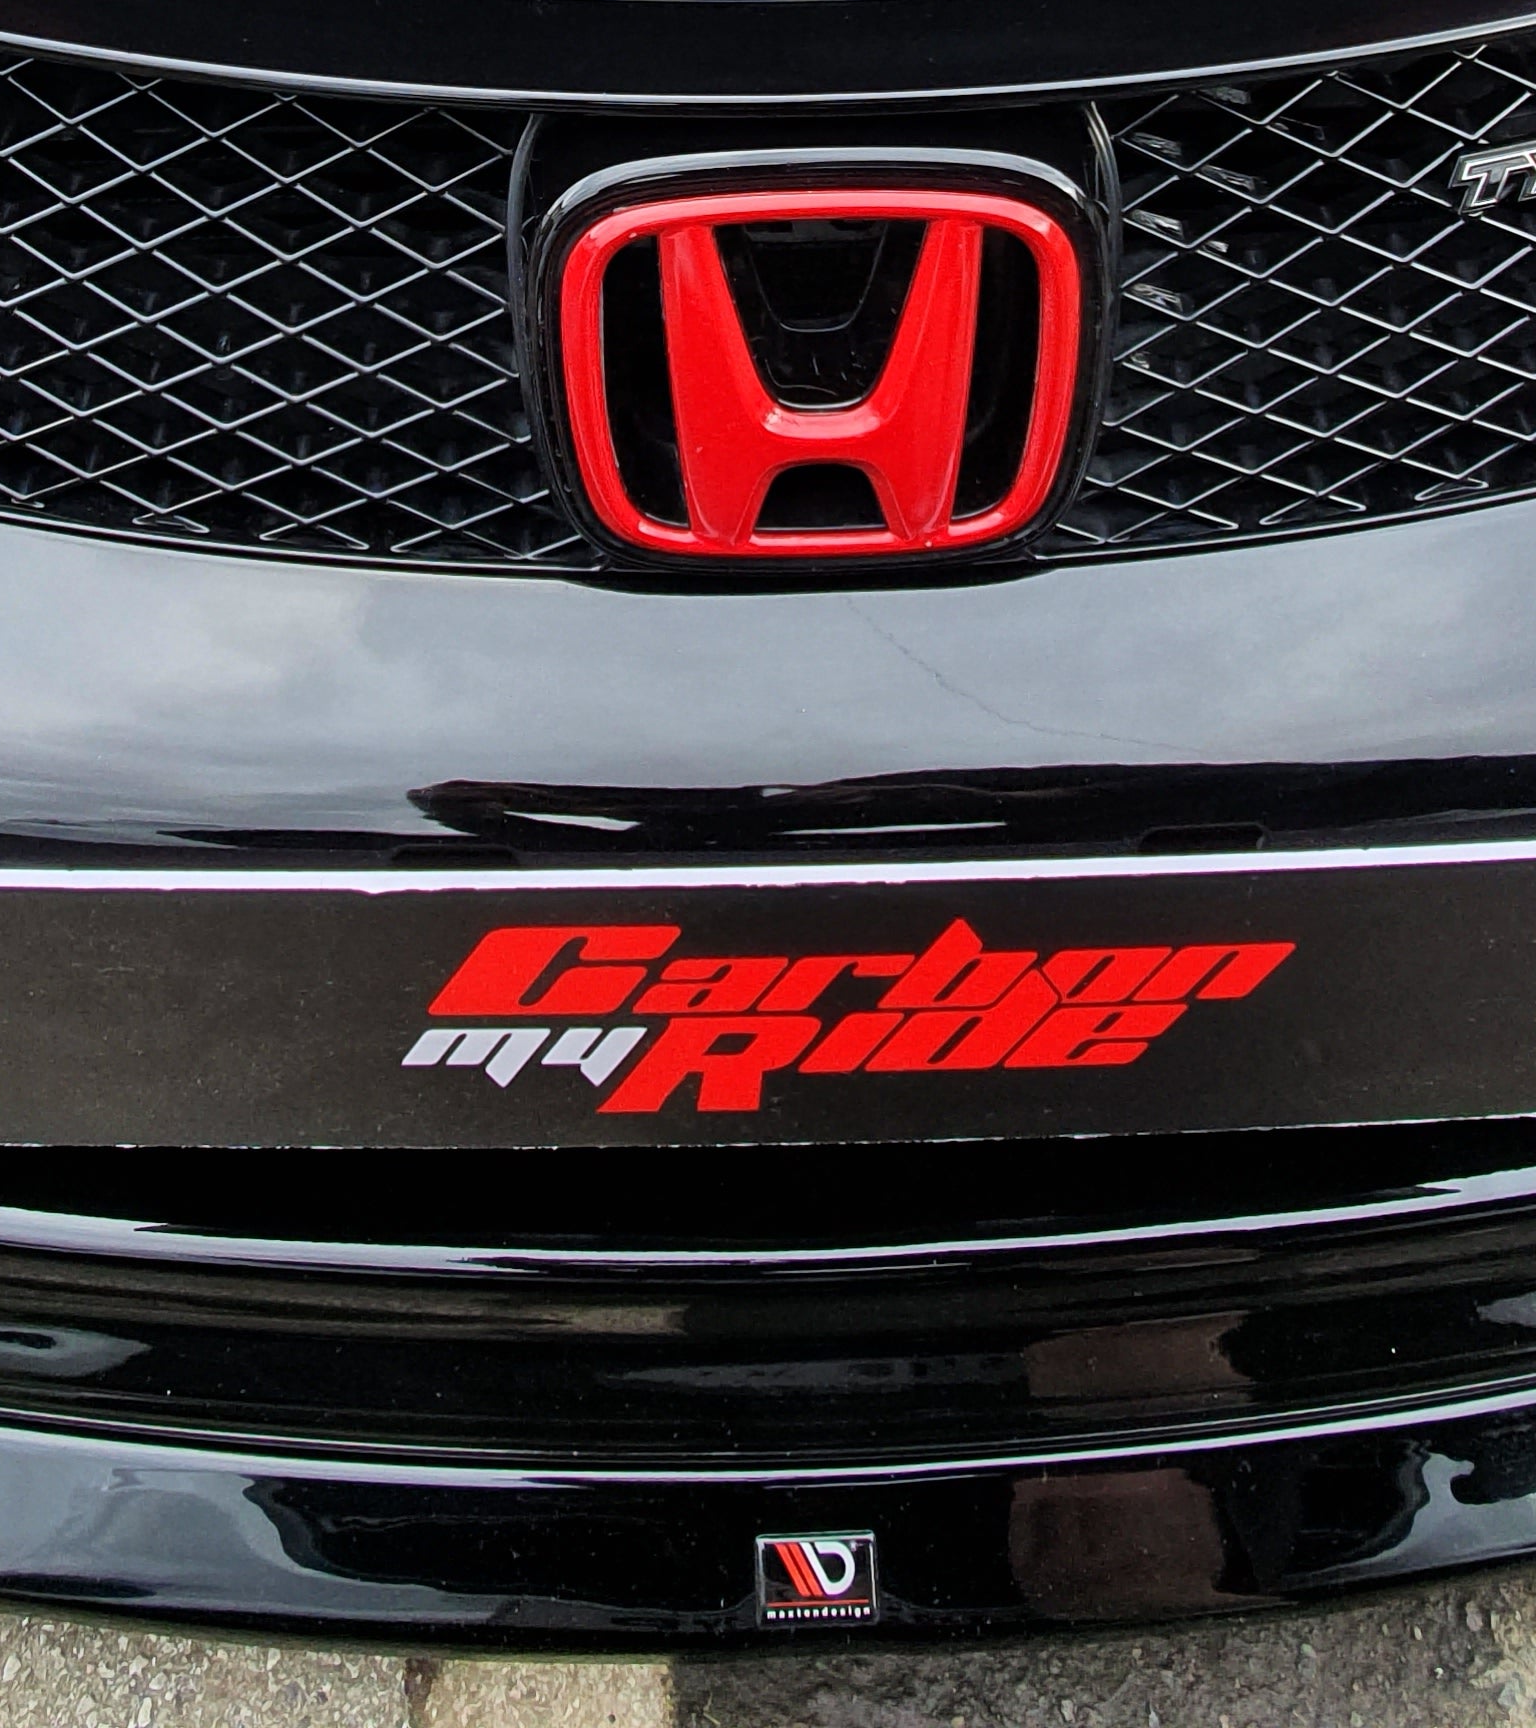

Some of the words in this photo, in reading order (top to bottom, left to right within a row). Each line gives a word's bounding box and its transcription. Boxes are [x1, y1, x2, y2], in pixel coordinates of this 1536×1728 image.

[427, 918, 1297, 1017] Carbon
[401, 1026, 649, 1088] my
[596, 969, 1189, 1114] Ride
